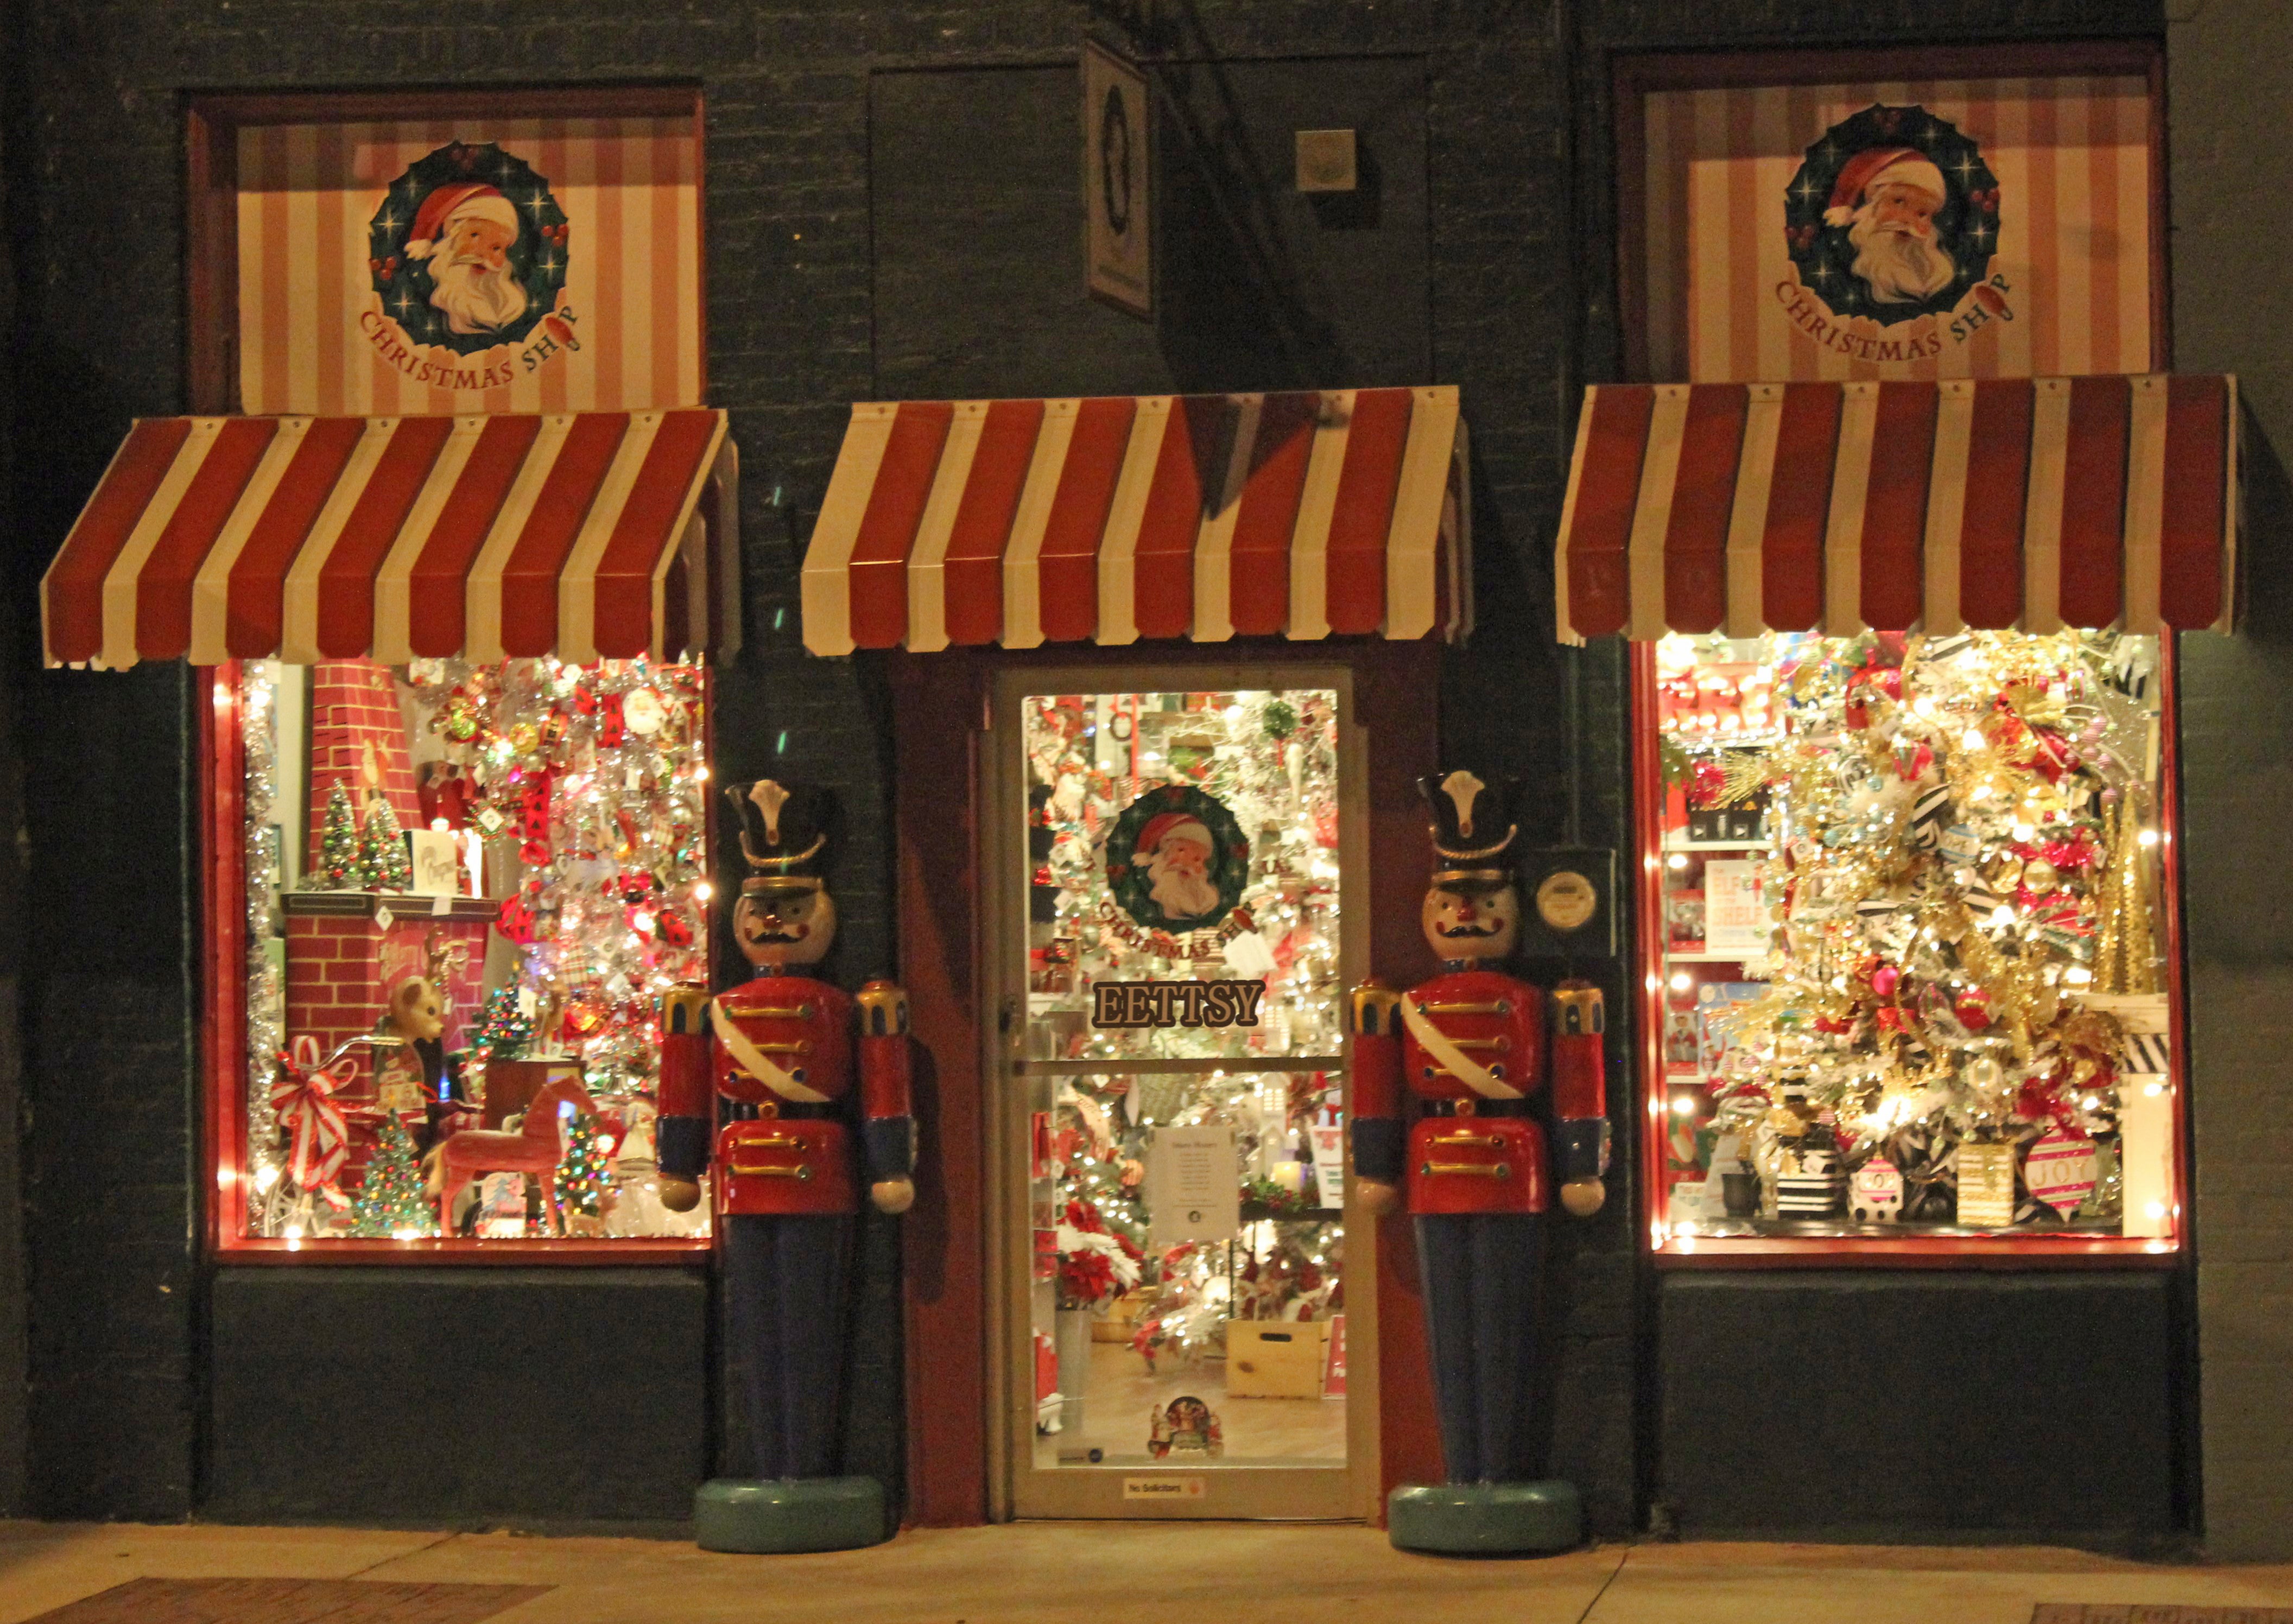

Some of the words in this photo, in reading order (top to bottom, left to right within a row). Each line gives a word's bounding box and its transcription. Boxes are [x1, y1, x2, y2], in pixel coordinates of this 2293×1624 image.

[360, 310, 514, 390] CHRISTMAS
[1776, 281, 1942, 361] CHRISTMAS
[1093, 981, 1264, 1026] EETTSY
[2031, 1157, 2089, 1187] JOY
